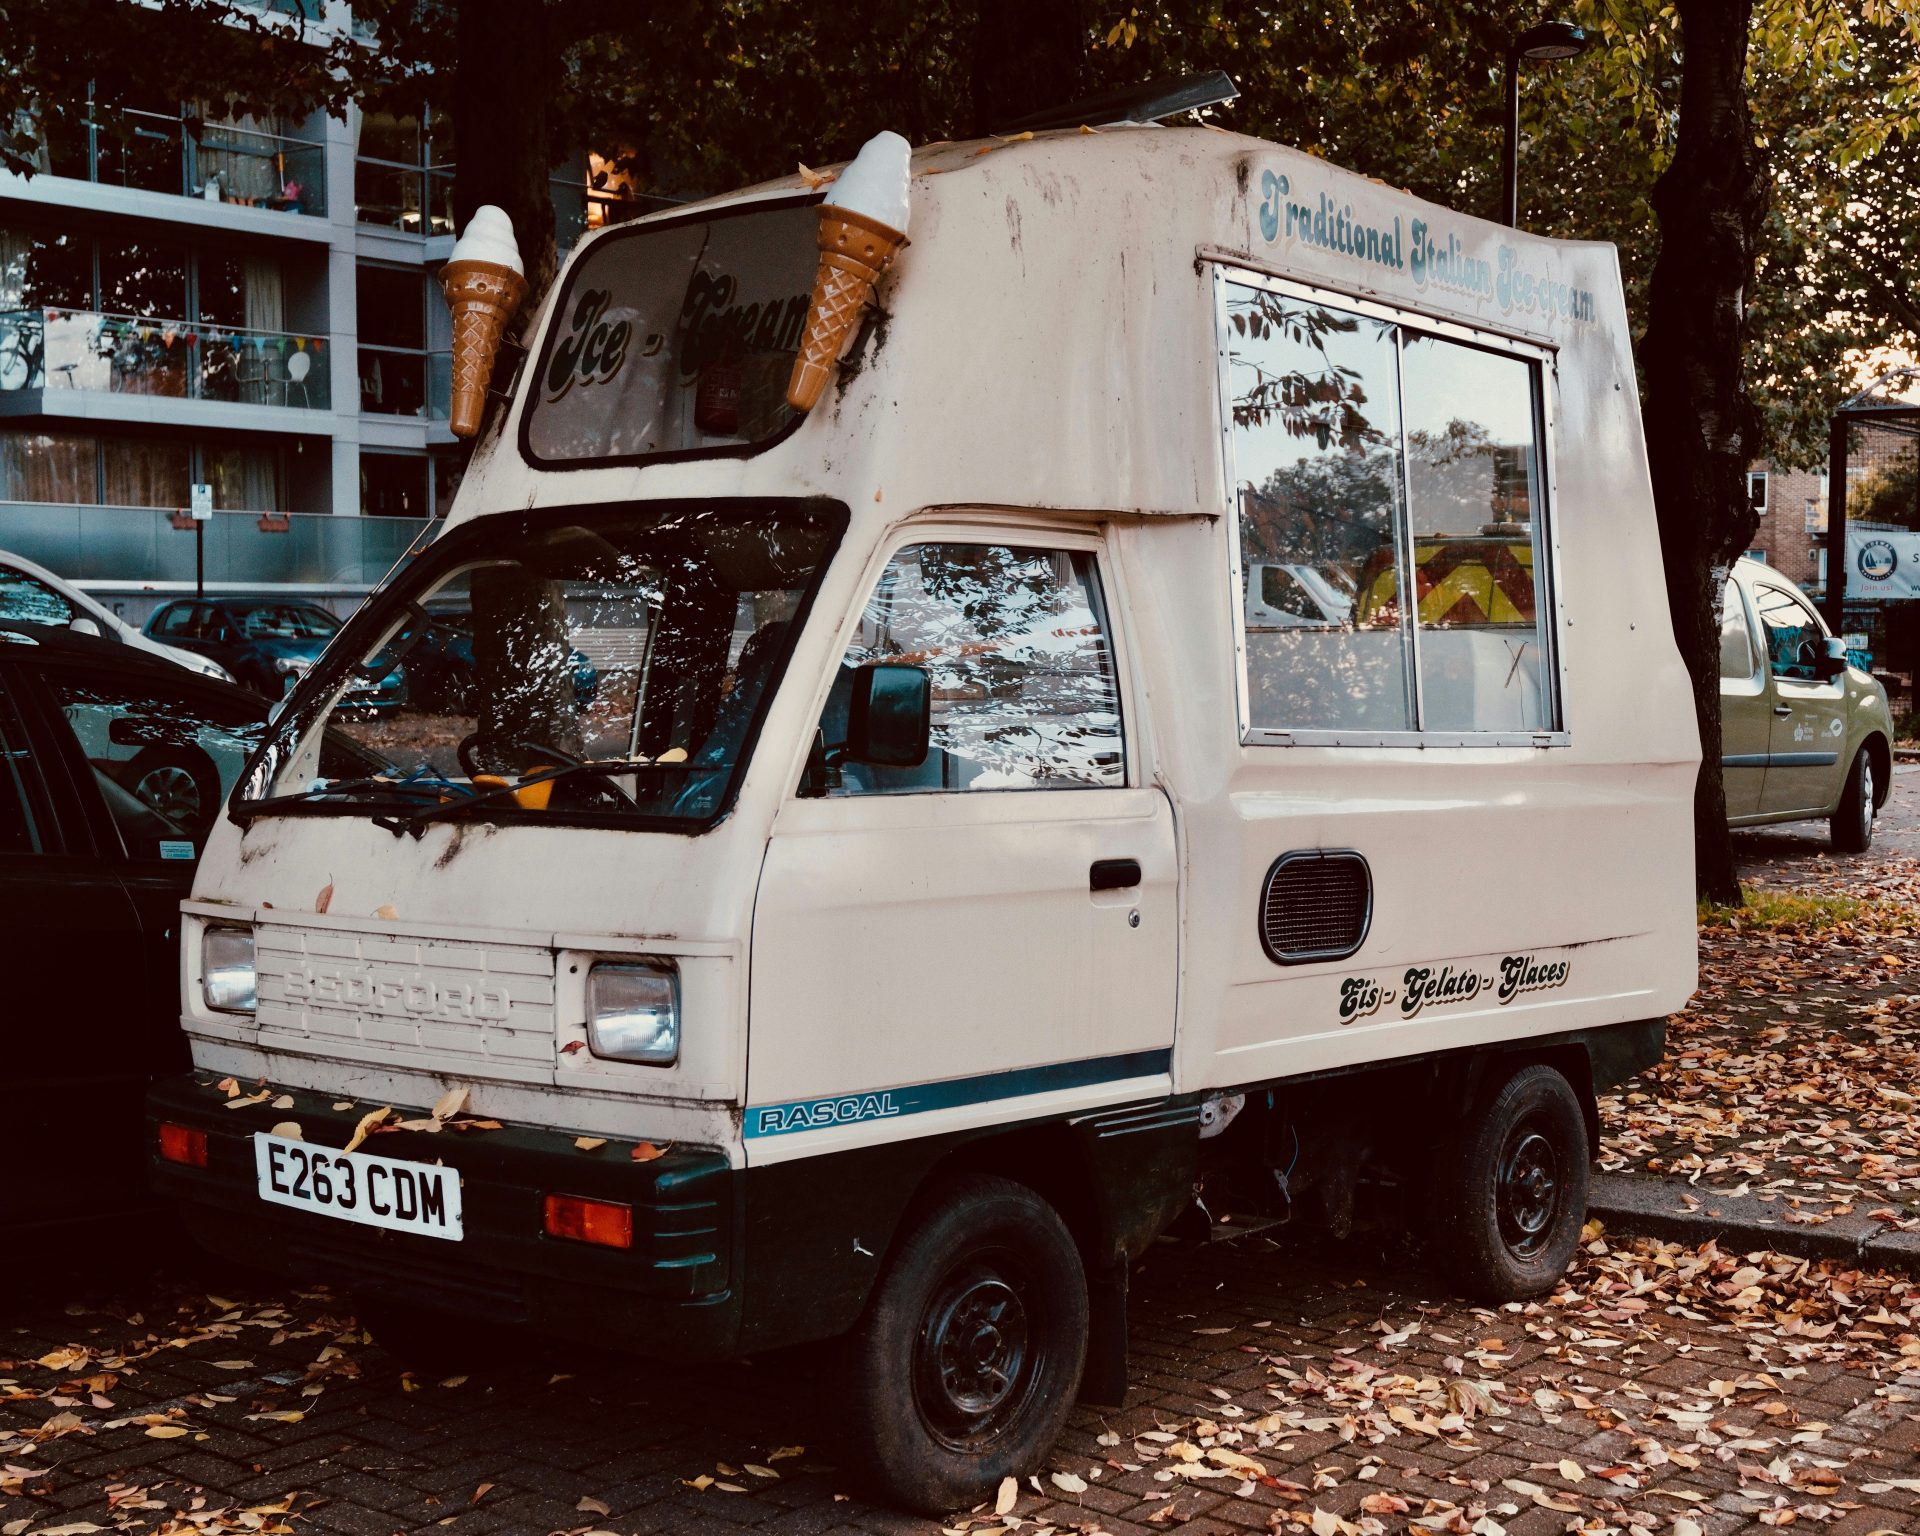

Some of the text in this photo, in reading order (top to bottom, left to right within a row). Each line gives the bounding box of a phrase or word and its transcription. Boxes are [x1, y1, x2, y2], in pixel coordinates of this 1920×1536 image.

[1259, 168, 1404, 271] Traditional
[1411, 217, 1493, 298] Italian
[548, 288, 630, 394] Ice
[283, 970, 511, 1022] BEDFORD
[1498, 956, 1566, 999] Glaces
[759, 1093, 900, 1133] RASCAL
[268, 1142, 446, 1227] E263 CDM
